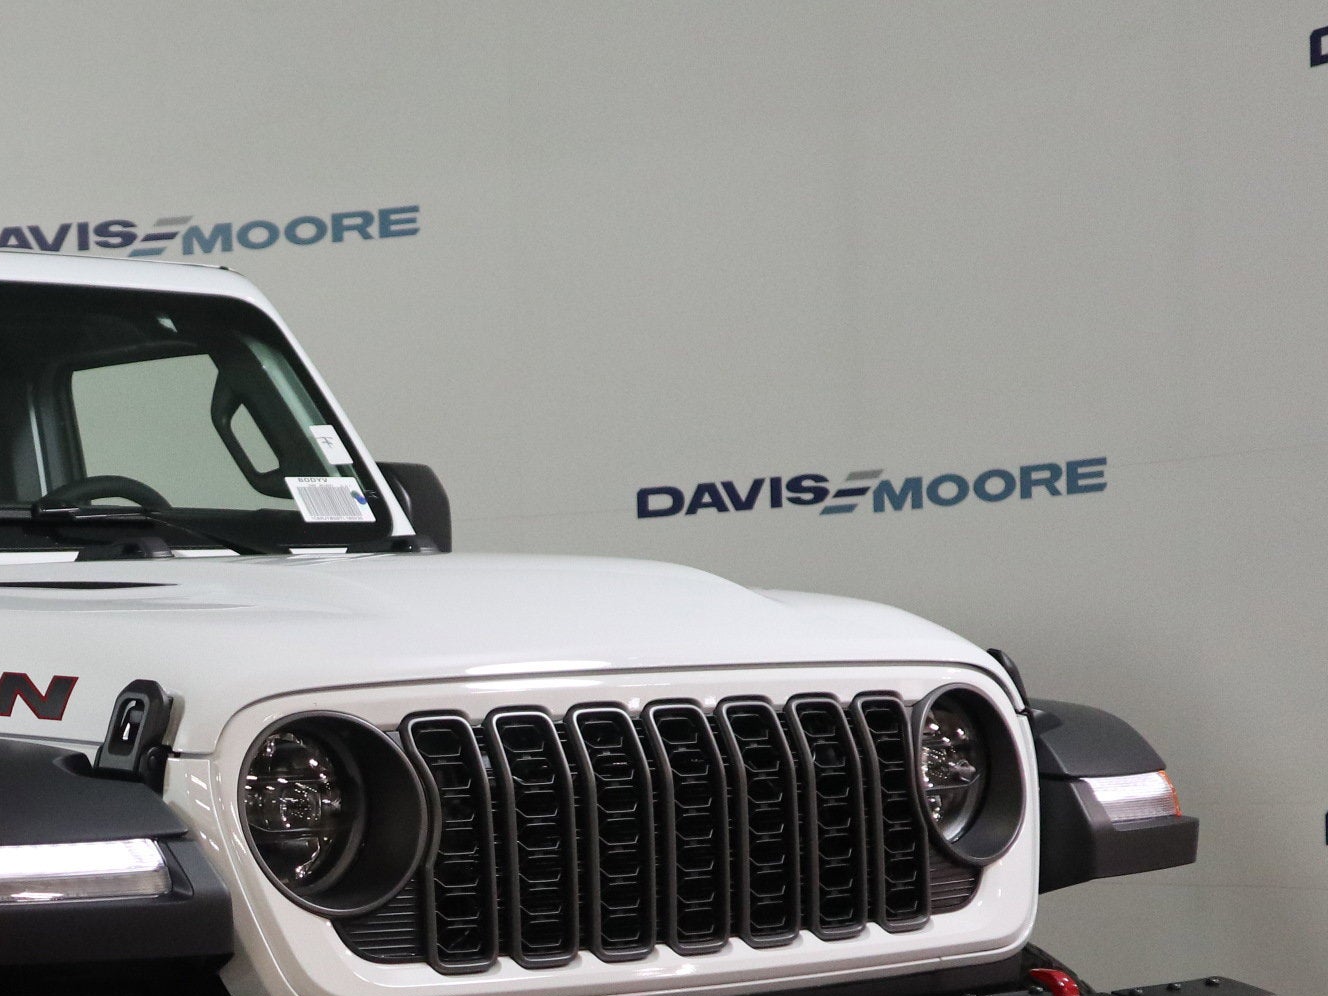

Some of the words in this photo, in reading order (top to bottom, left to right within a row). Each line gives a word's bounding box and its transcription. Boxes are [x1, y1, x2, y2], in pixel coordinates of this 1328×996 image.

[182, 205, 419, 256] MOORE
[637, 474, 830, 519] DAVIS
[873, 456, 1108, 513] MOORE
